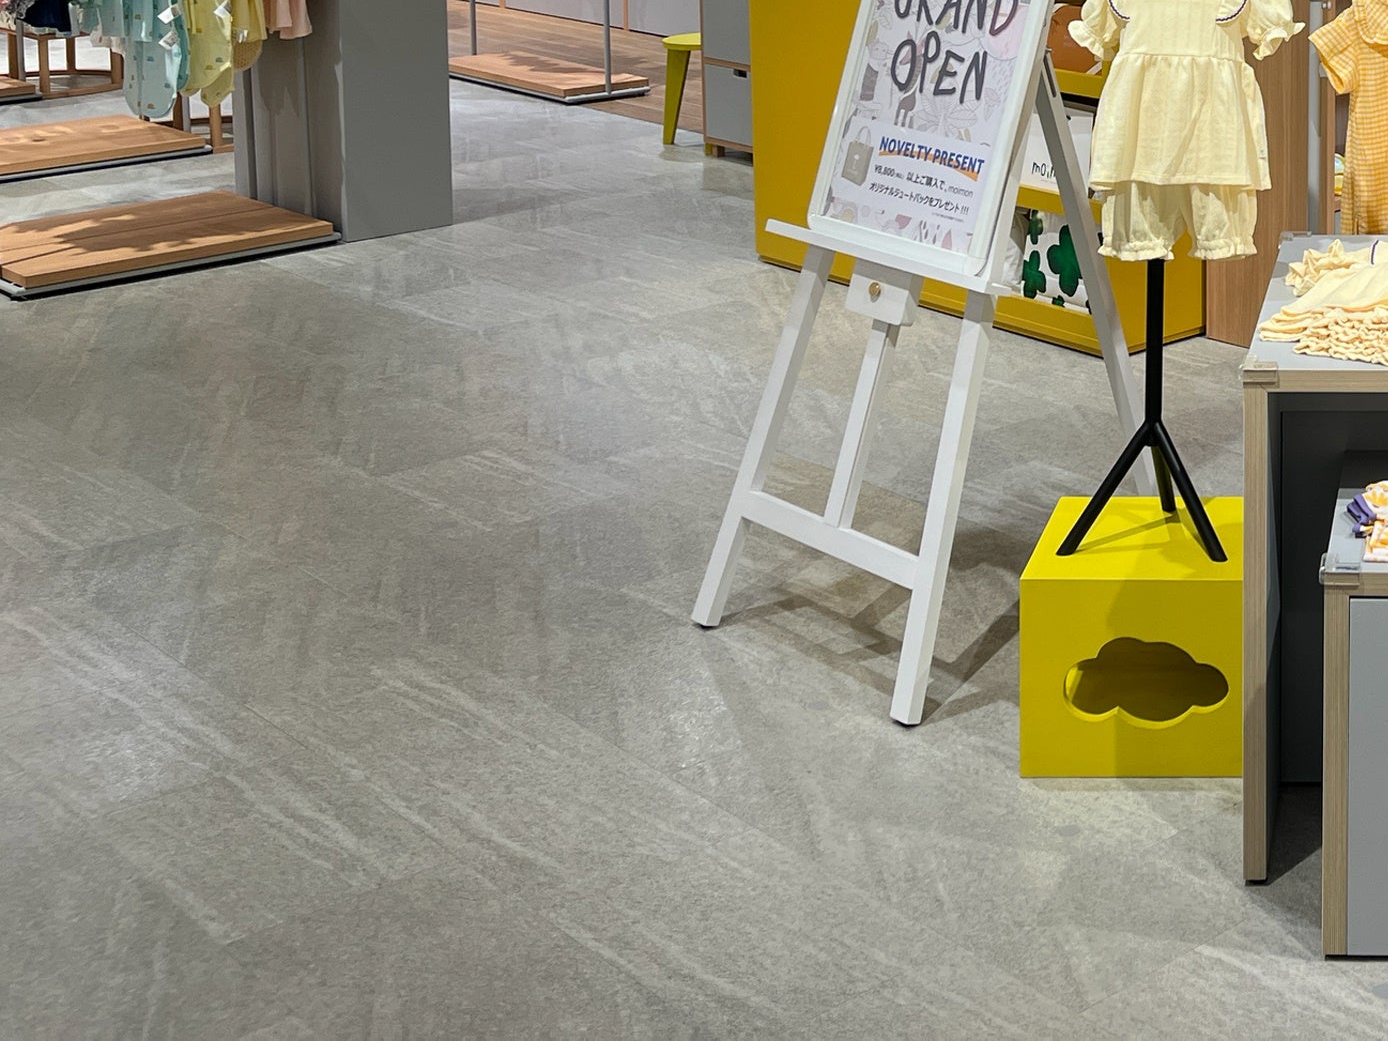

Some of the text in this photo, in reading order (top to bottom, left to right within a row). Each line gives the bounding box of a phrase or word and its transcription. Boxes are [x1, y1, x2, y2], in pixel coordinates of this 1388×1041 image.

[890, 30, 988, 104] OPEN
[879, 136, 985, 174] NOVELTY PRESENT
